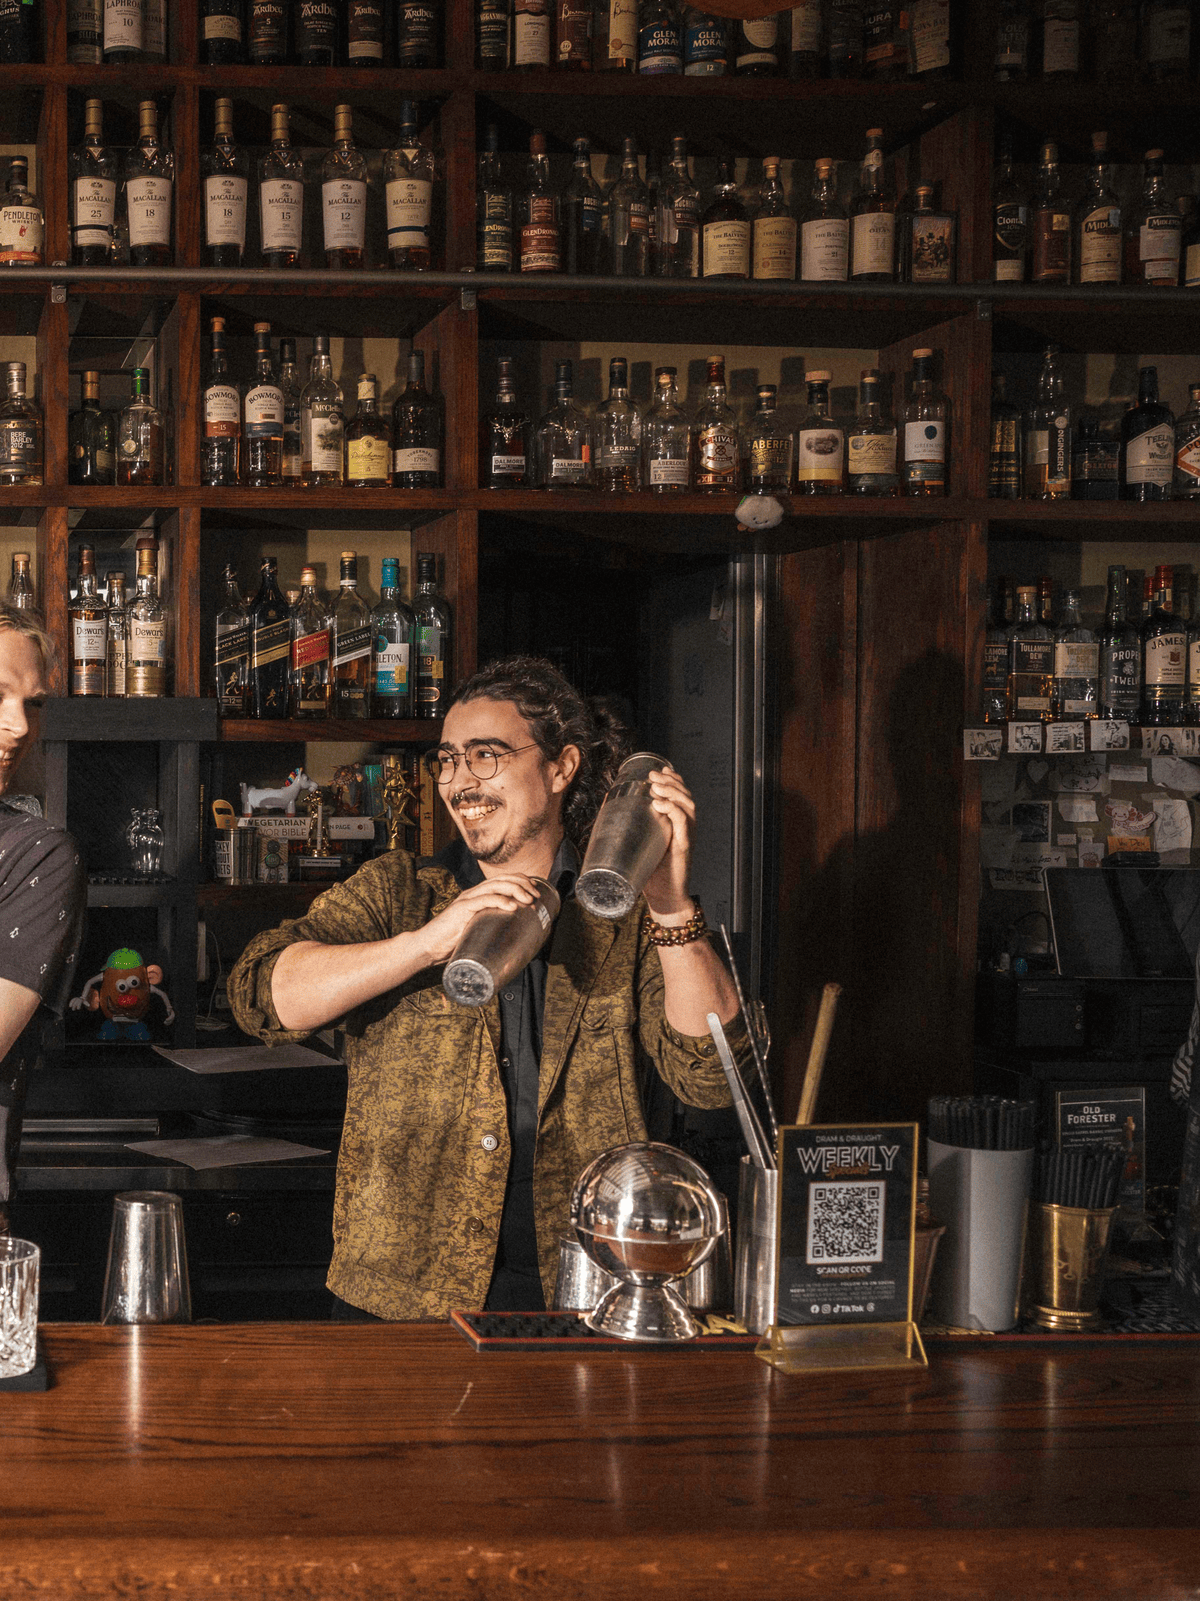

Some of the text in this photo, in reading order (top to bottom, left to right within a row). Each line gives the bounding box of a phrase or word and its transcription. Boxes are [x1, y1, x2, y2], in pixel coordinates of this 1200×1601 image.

[123, 19, 134, 27] 10
[653, 31, 676, 39] GLEN
[698, 31, 721, 39] GLEN
[647, 38, 679, 48] MORAY
[79, 195, 111, 204] MACALLAN
[133, 195, 167, 204] MACALLAN
[210, 194, 243, 202] MACALLAN
[268, 198, 300, 206] MACALLAN
[328, 198, 361, 206] MACALLAN
[393, 198, 426, 206] MACALLAN
[3, 211, 40, 222] PENDLETON
[91, 210, 102, 218] 25
[146, 209, 155, 217] 18
[223, 208, 233, 217] 18
[281, 212, 291, 220] 15
[341, 212, 351, 220] 12
[705, 435, 735, 444] CHIVAS
[77, 626, 105, 637] Dewar's
[135, 626, 164, 637] Dewar's
[232, 635, 249, 647] LABEL
[337, 631, 371, 649] GREEN LABEL
[1020, 643, 1052, 653] TULLAMORE
[1029, 653, 1044, 661] DEW
[341, 690, 349, 698] 15
[281, 828, 307, 837] BIBLE
[1083, 1106, 1100, 1114] OLD
[1067, 1113, 1116, 1125] FORESTER
[815, 1135, 837, 1143] DRAM
[845, 1134, 882, 1142] DRAUGHT
[797, 1145, 899, 1174] WEEKLY
[816, 1266, 838, 1275] SCAN
[850, 1265, 872, 1274] CODE
[841, 1304, 864, 1313] TikTok
